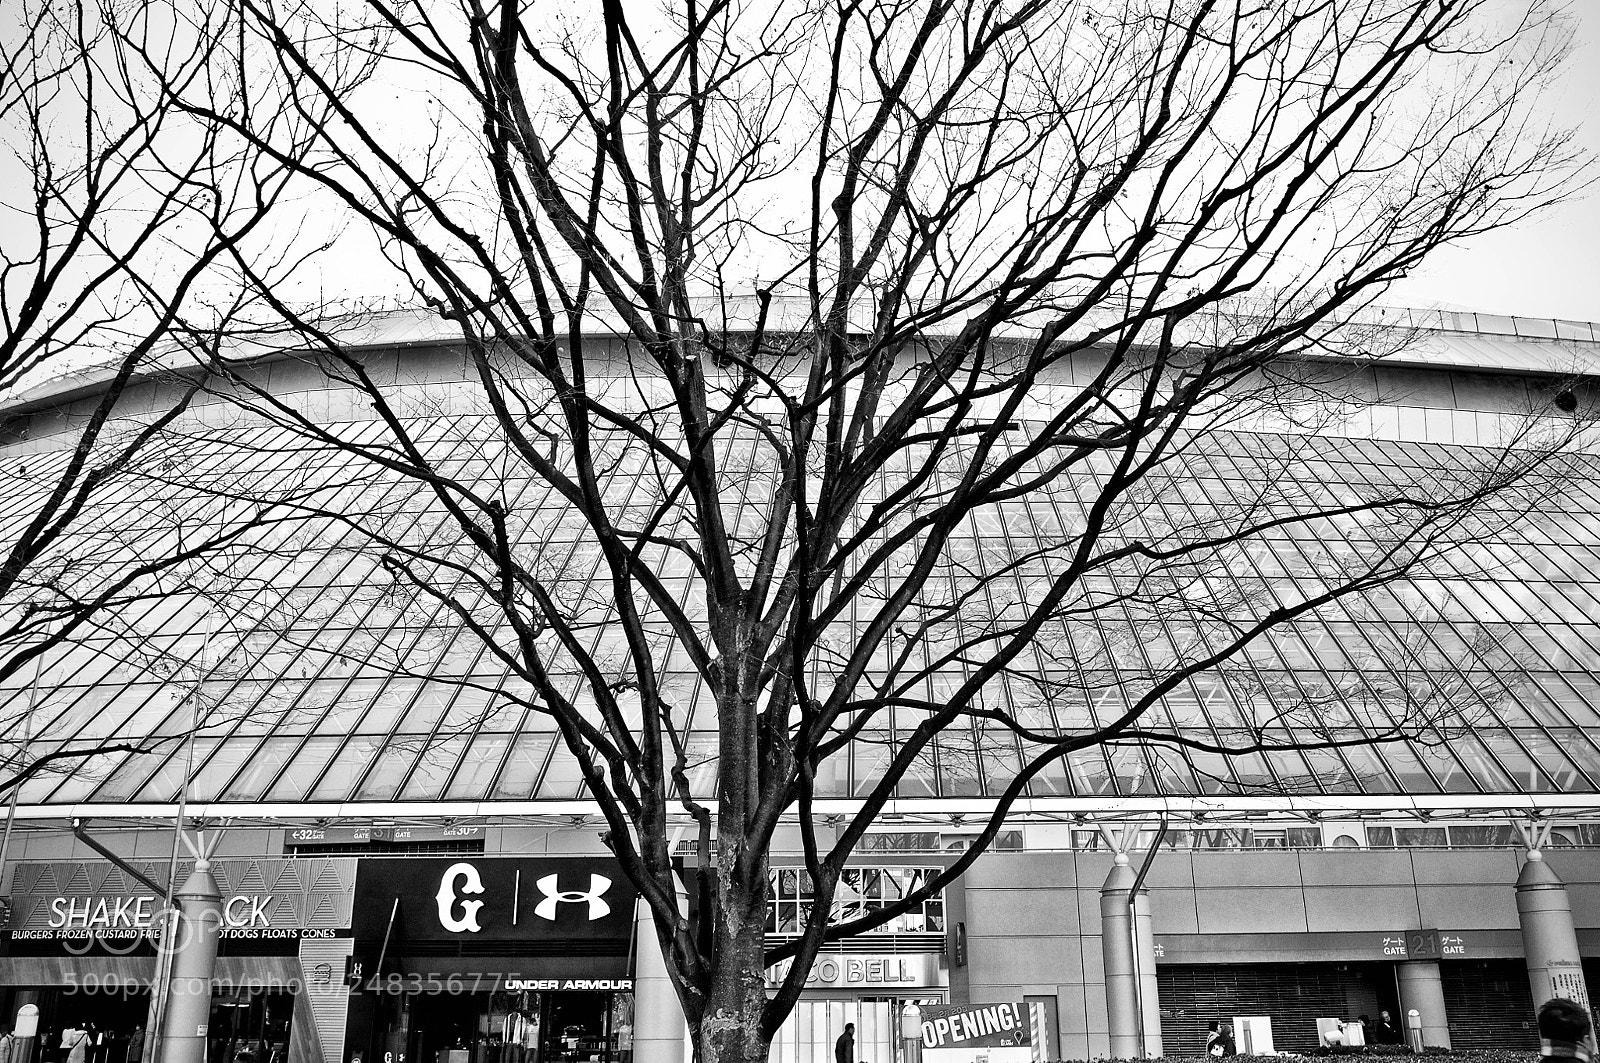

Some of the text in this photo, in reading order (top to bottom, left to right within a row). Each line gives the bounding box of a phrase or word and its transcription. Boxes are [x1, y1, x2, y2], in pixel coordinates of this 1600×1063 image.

[299, 829, 312, 840] 32
[435, 862, 485, 932] G
[47, 896, 155, 928] SHAKE
[11, 929, 336, 940] BURGERS FROZEN CUSTARD FRIE OT DOGS FLOATS CONES
[1382, 937, 1404, 946] ゲート
[1413, 935, 1437, 954] 21
[1441, 936, 1463, 945] ゲート
[1383, 947, 1406, 955] GATE
[1443, 946, 1465, 954] GATE
[846, 959, 915, 983] BELL
[504, 980, 632, 990] UNDER ARMOUR
[921, 1002, 1022, 1048] OPENING!
